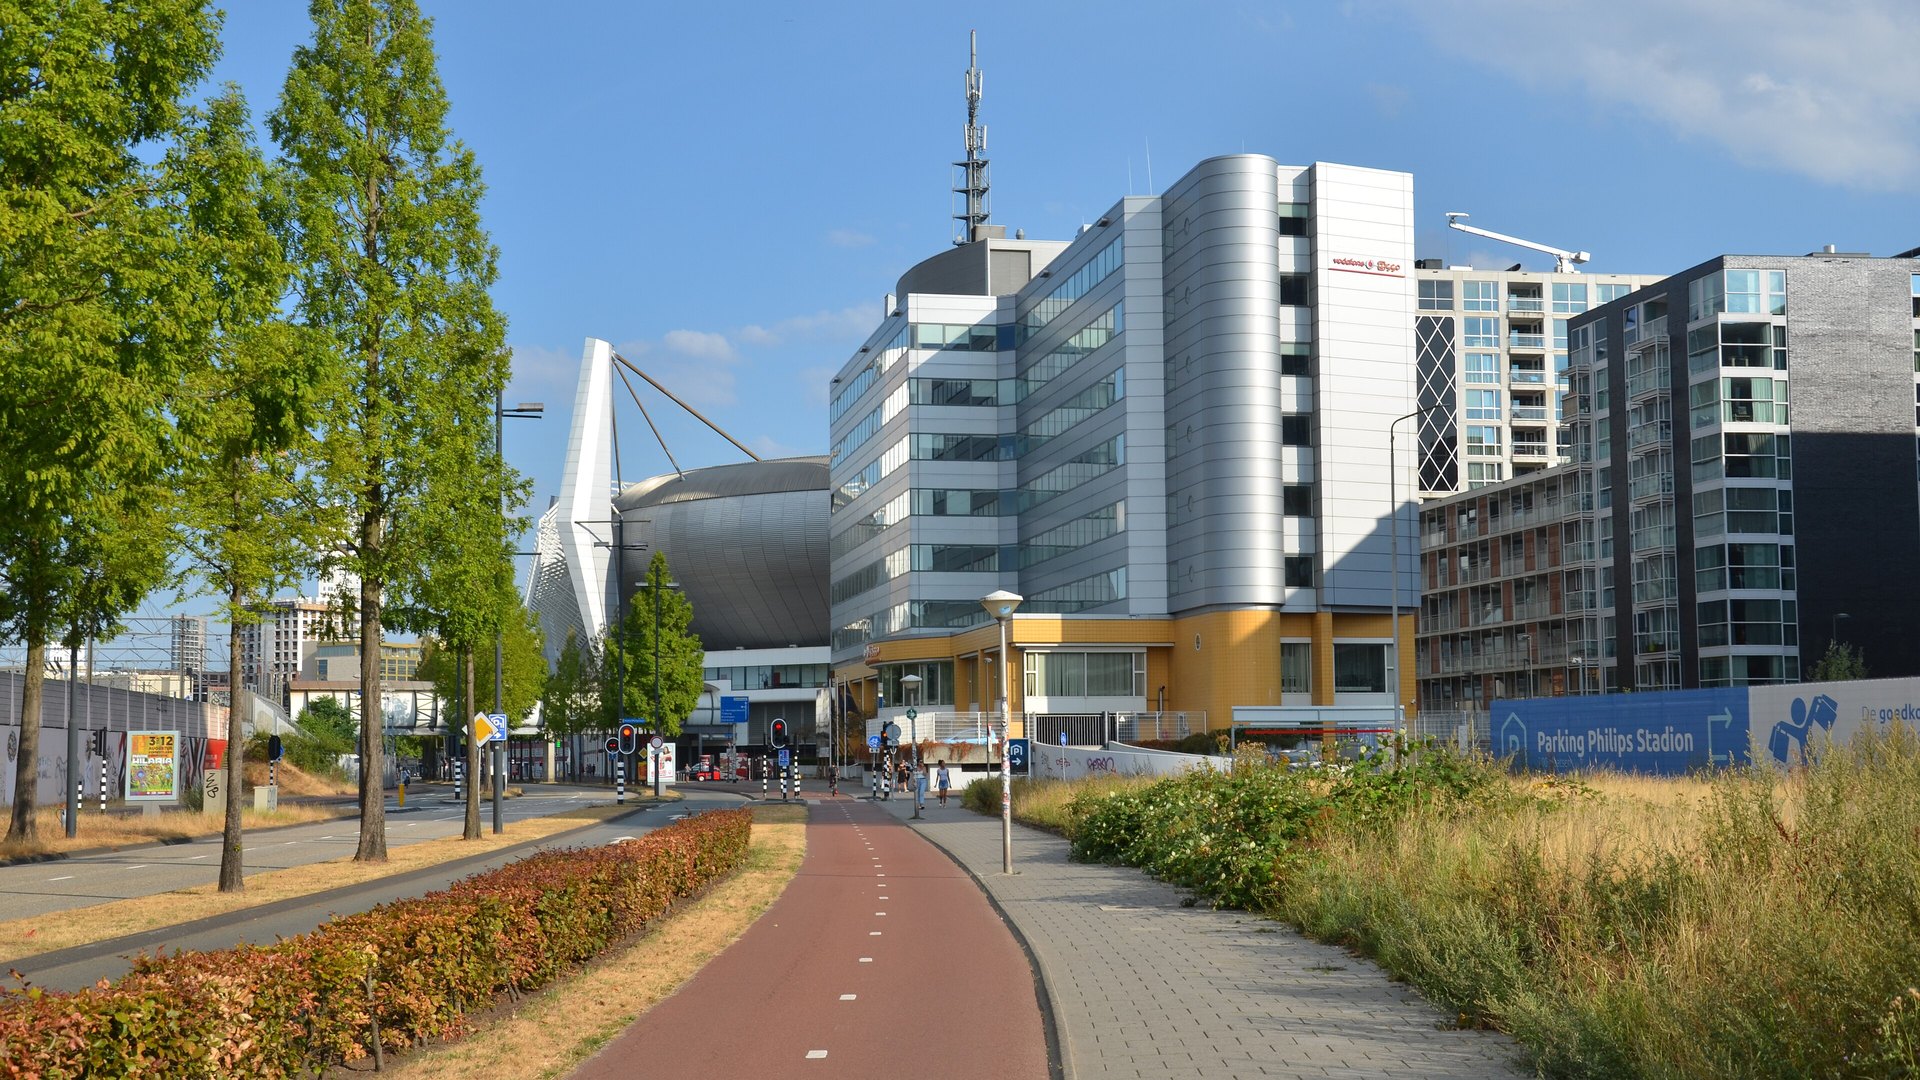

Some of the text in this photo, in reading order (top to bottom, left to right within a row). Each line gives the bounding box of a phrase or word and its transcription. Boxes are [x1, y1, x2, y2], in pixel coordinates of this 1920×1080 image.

[1861, 706, 1877, 722] De
[149, 736, 173, 746] 3 12
[1537, 725, 1694, 758] Parking Philips Stadion
[1013, 748, 1020, 756] P
